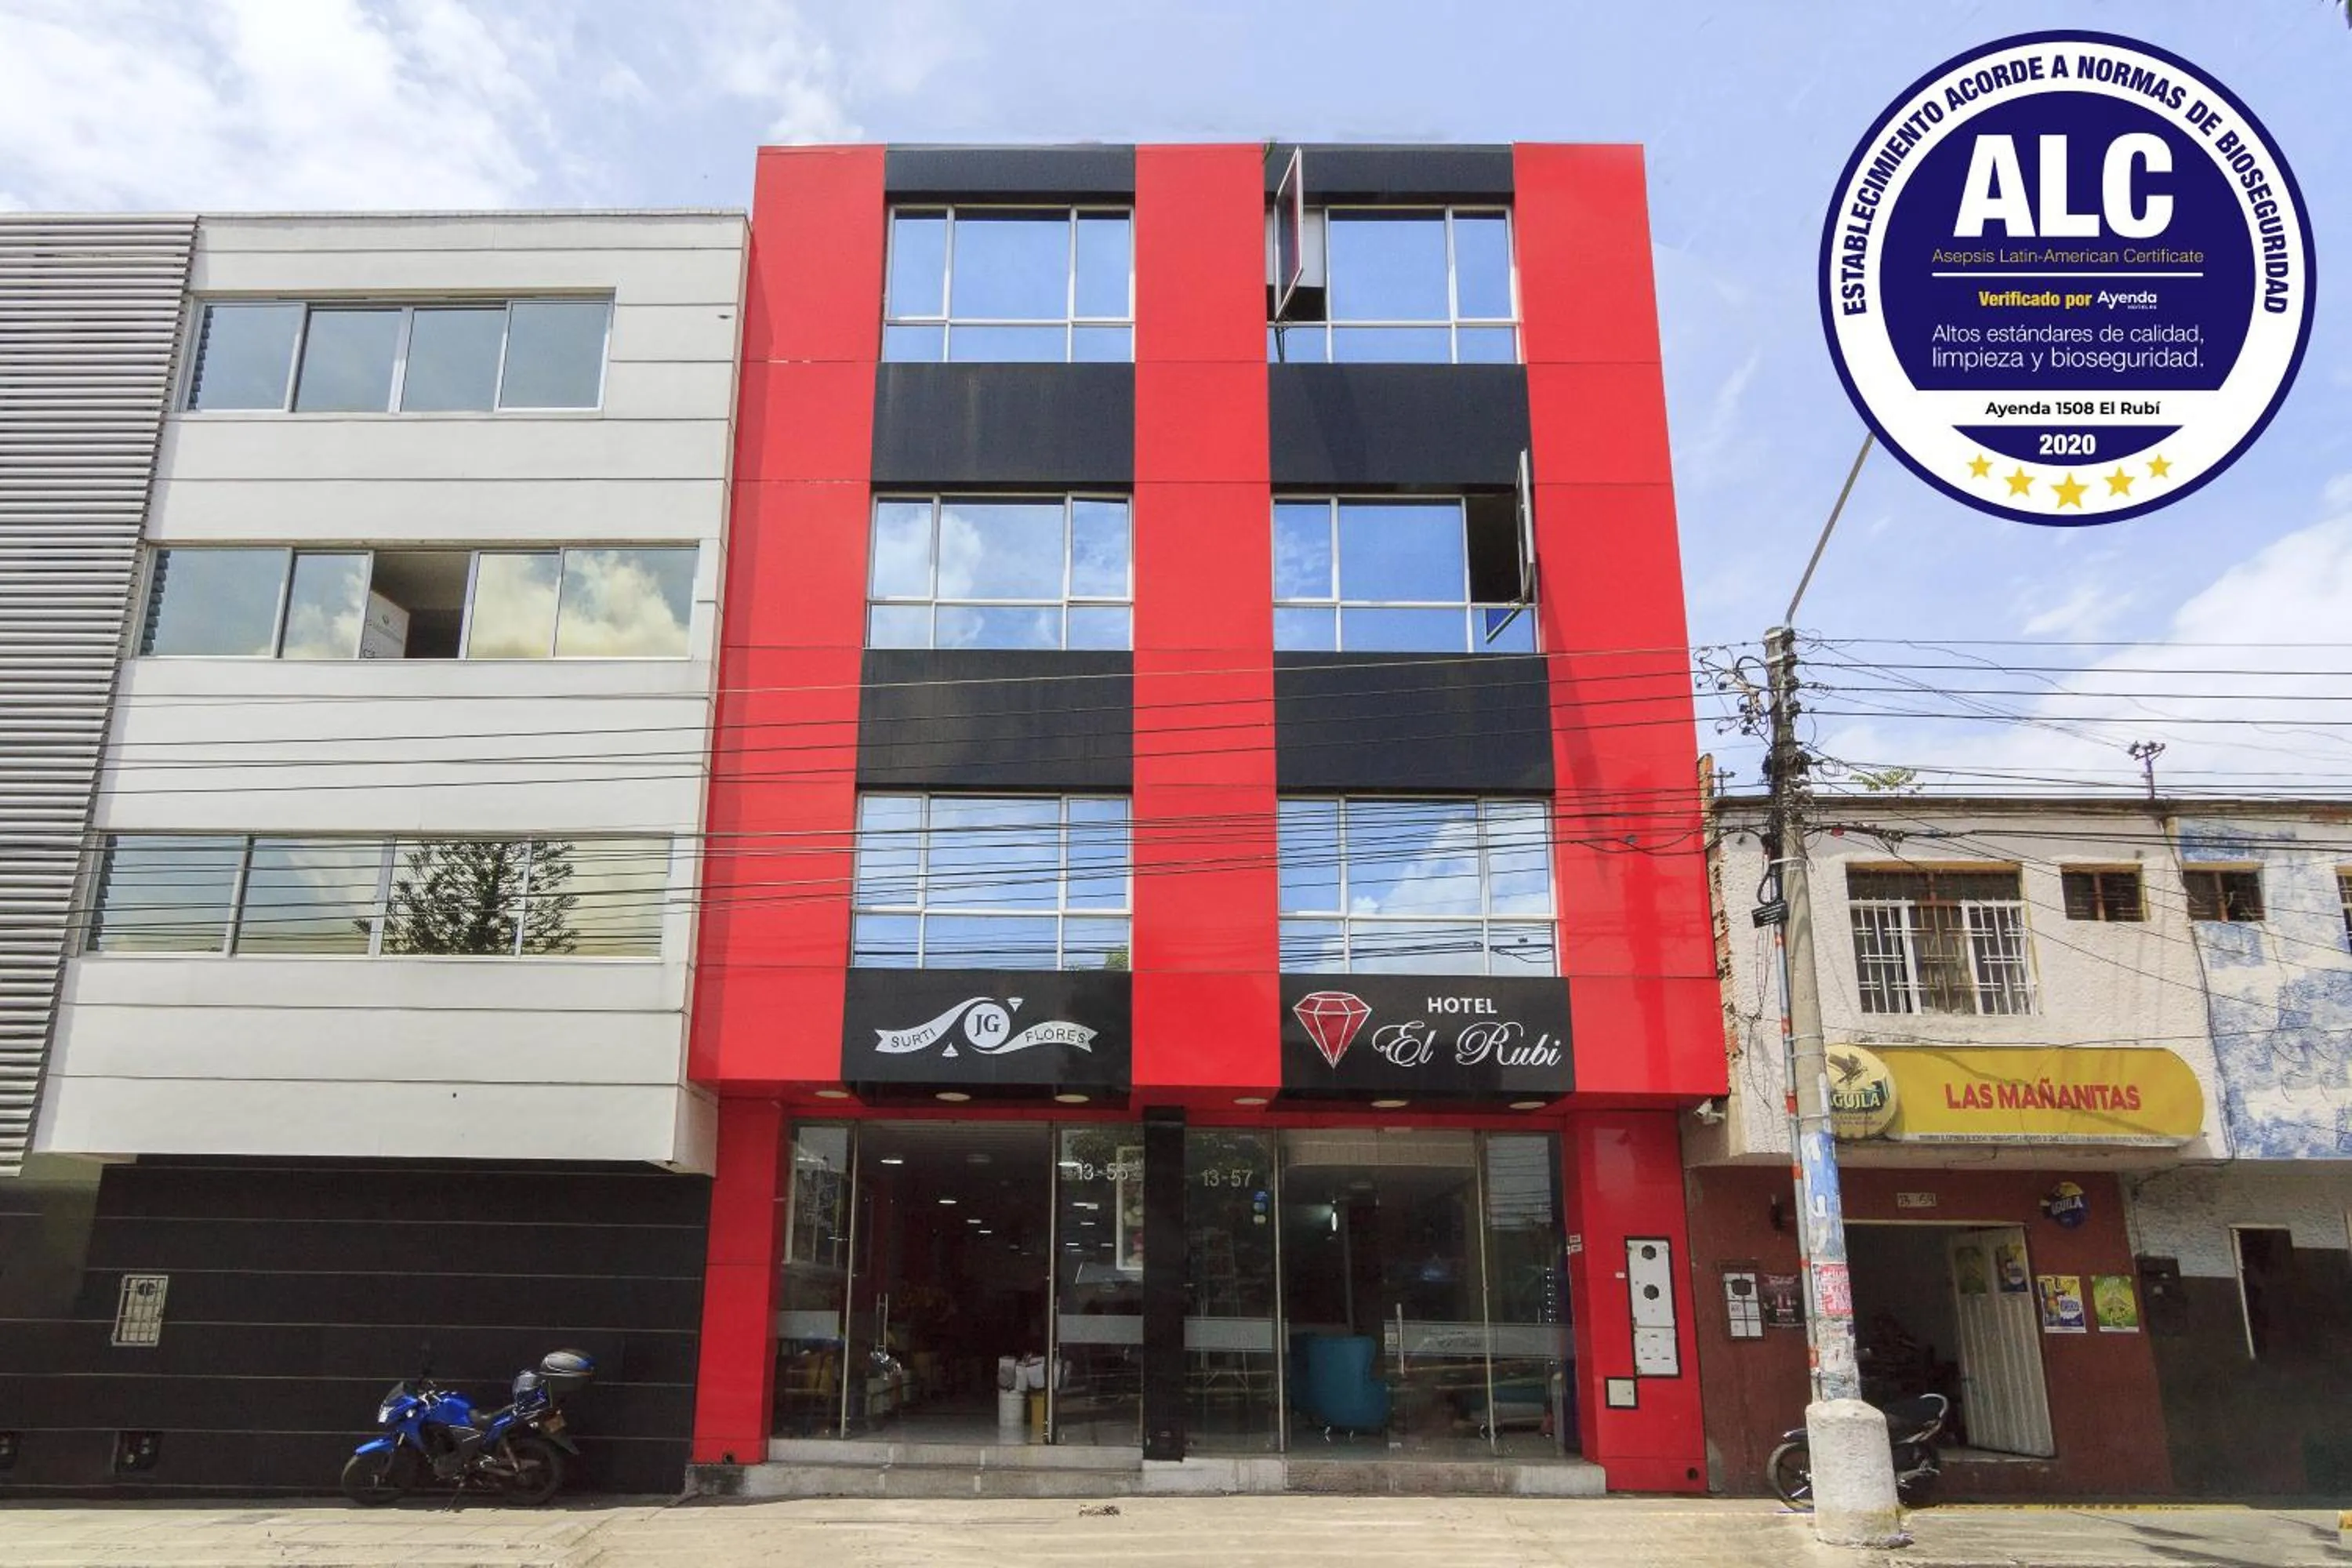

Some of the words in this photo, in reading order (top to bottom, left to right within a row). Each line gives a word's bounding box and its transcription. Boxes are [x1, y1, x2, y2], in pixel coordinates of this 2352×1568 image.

[1427, 996, 1498, 1014] HOTEL
[974, 1013, 1001, 1036] JG
[891, 1027, 938, 1049] SURTI
[1025, 1028, 1087, 1044] FLORES
[1371, 1020, 1438, 1068] El
[1454, 1021, 1563, 1066] Rubi
[1945, 1083, 1994, 1109] LAS
[1997, 1076, 2142, 1111] MAÑANITAS
[1203, 1169, 1254, 1189] 13-57
